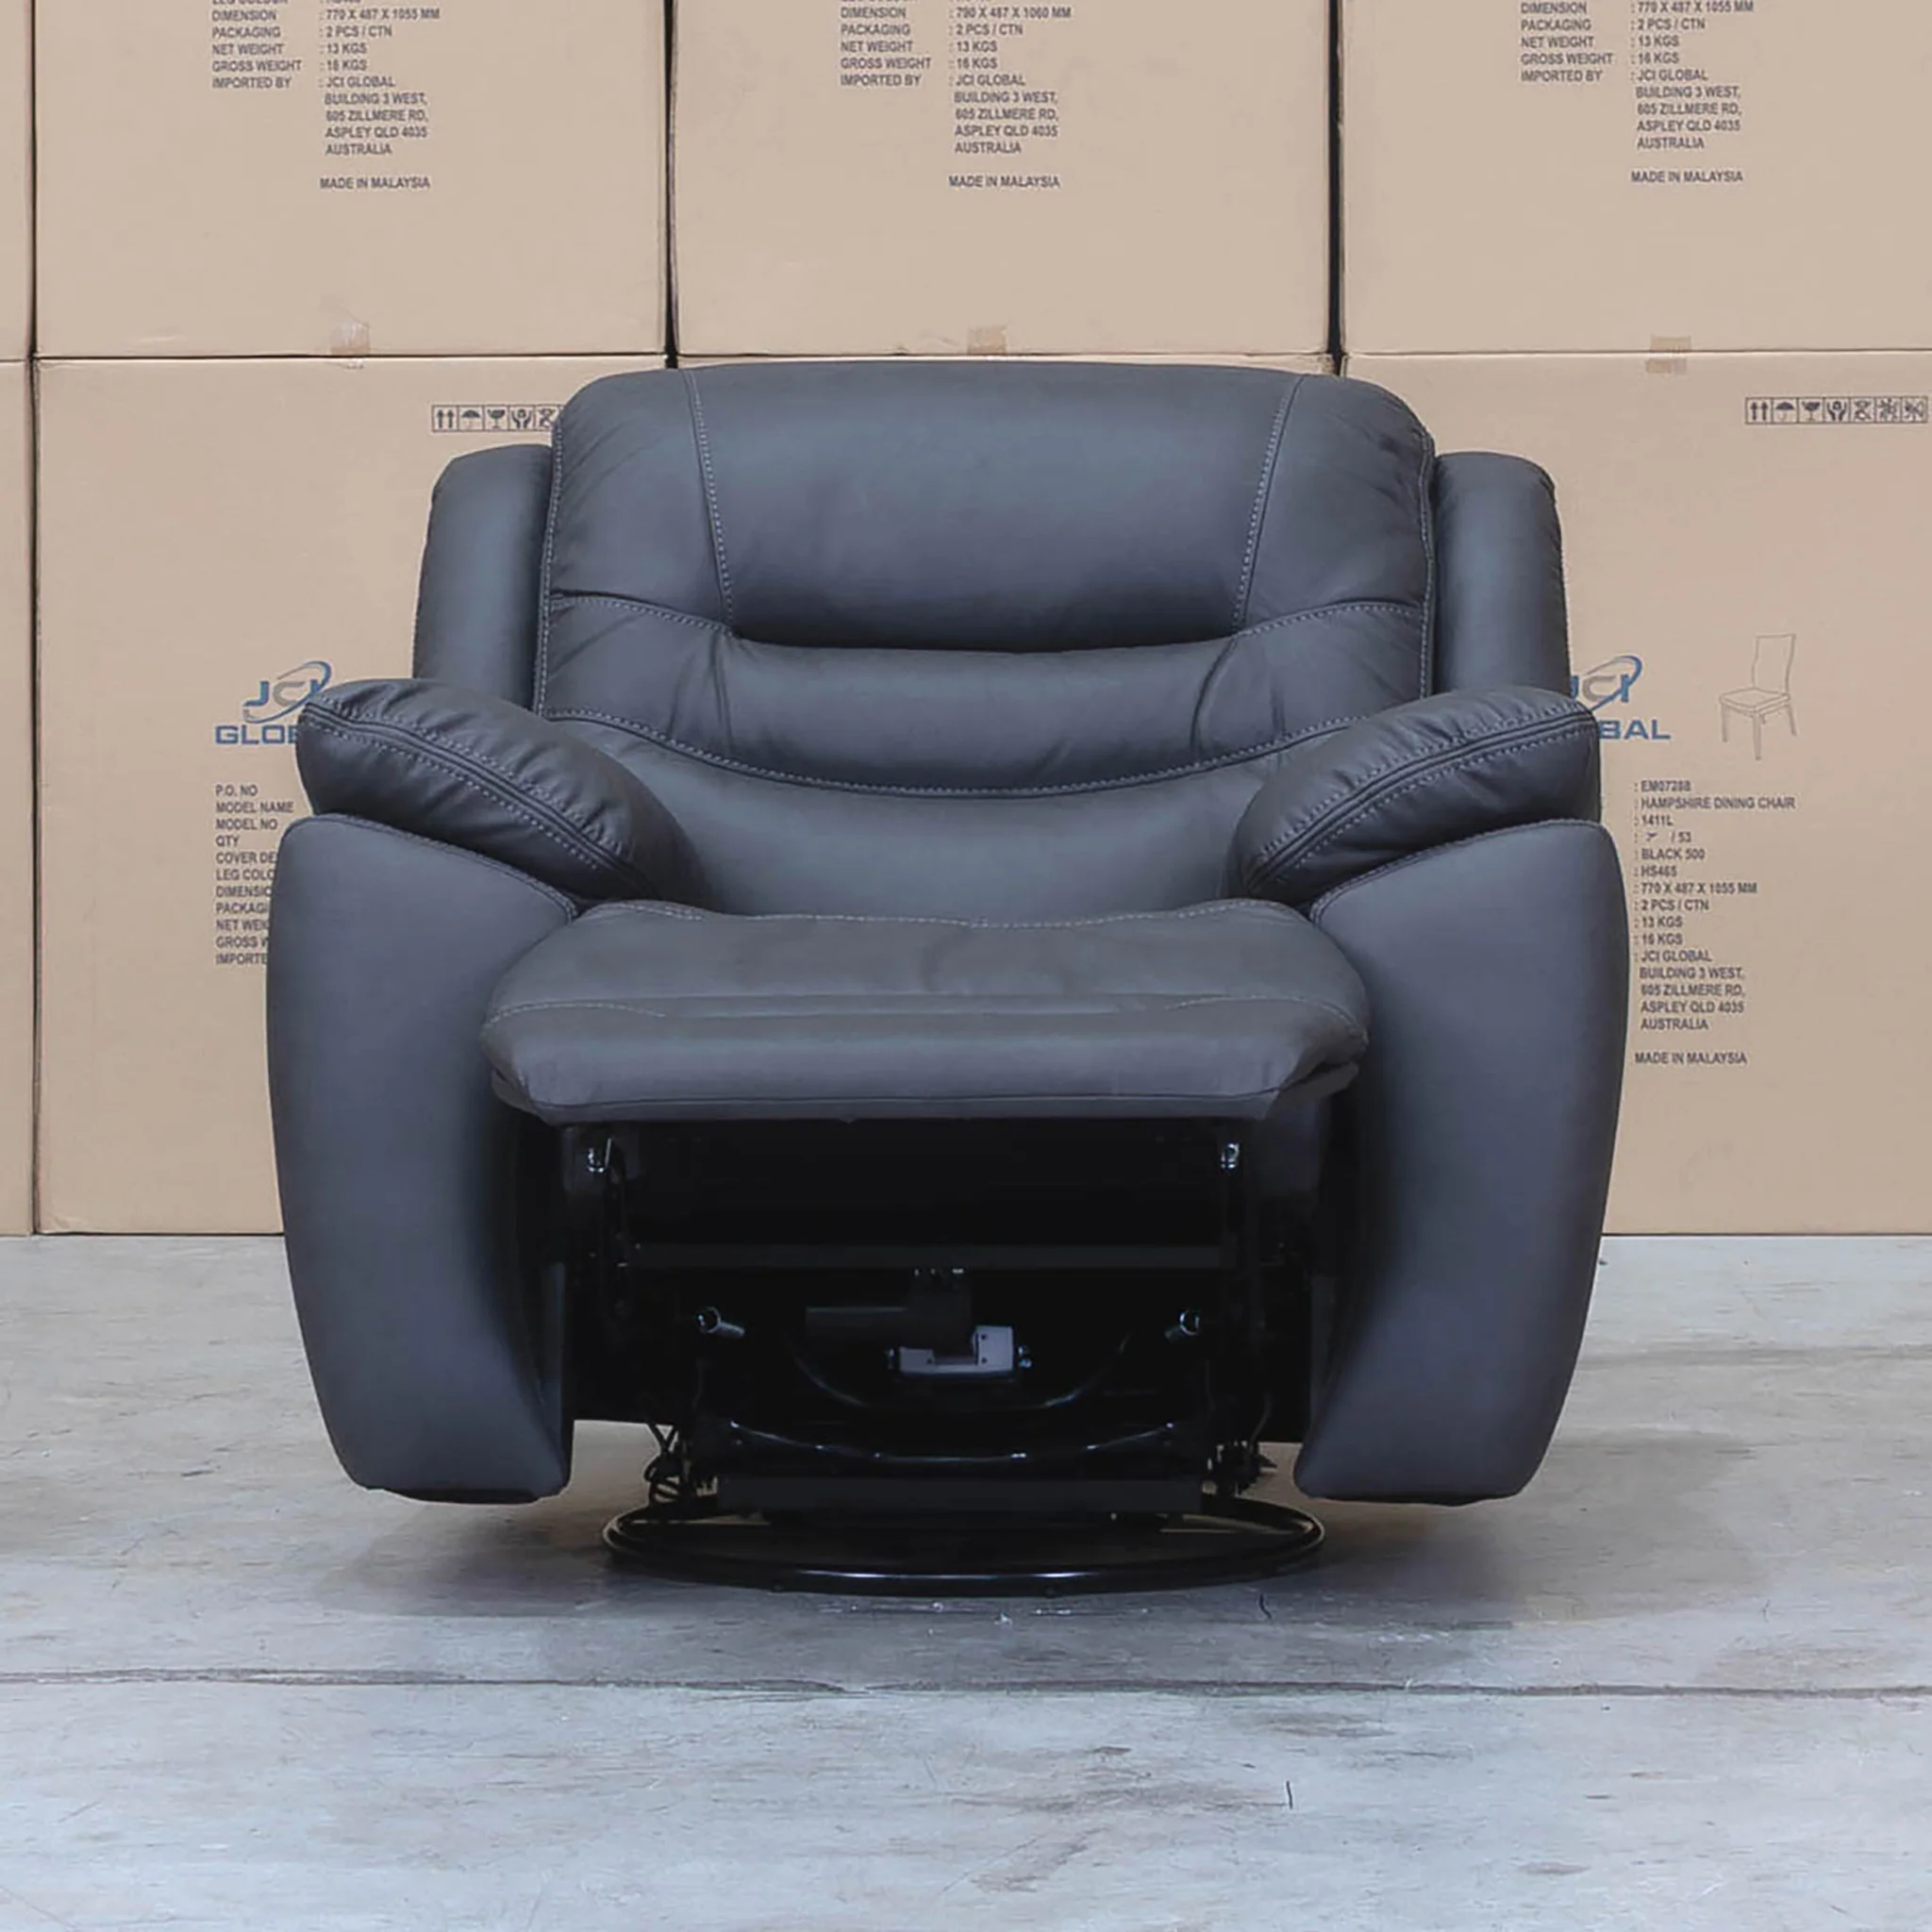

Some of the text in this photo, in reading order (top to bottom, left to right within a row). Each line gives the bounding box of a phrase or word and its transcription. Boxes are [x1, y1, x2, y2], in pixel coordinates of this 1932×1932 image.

[841, 7, 906, 19] DIMENSION
[1521, 2, 1587, 14] DIMENSION
[212, 9, 276, 22] DIMENSION
[841, 24, 910, 36] PACKAGING
[966, 24, 990, 36] PCS
[999, 24, 1023, 36] CTN
[1521, 19, 1591, 31] PACKAGING
[1647, 18, 1672, 30] PCS
[1680, 18, 1706, 30] CTN
[212, 26, 281, 38] PACKAGING
[335, 25, 358, 37] PCS
[368, 25, 392, 37] CTN
[841, 41, 913, 53] NET WEIGHT
[973, 41, 998, 53] KGS
[1521, 36, 1594, 48] NET WEIGHT
[1654, 35, 1679, 47] KGS
[212, 43, 284, 56] NET WEIGHT
[341, 42, 367, 54] KGS
[841, 58, 931, 70] GROSS WEIGHT
[972, 58, 998, 69] KGS
[1521, 53, 1613, 65] GROSS WEIGHT
[1654, 53, 1679, 64] KGS
[212, 59, 302, 73] GROSS WEIGHT
[341, 59, 367, 71] KGS
[841, 75, 922, 86] IMPORTED BY
[954, 75, 1025, 86] JCI GLOBAL
[1521, 70, 1603, 82] IMPORTED BY
[1636, 69, 1708, 81] JCI GLOBAL
[212, 77, 291, 89] IMPORTED BY
[325, 76, 396, 88] JCI GLOBAL
[954, 92, 1010, 103] BUILDING
[1636, 86, 1692, 98] BUILDING
[325, 93, 380, 105] BUILDING
[977, 108, 1036, 121] ZILLMERE
[1659, 103, 1719, 115] ZILLMERE
[347, 109, 406, 122] ZILLMERE
[955, 125, 1002, 137] ASPLEY
[1003, 125, 1029, 137] QLD
[1636, 120, 1684, 132] ASPLEY
[1686, 120, 1711, 132] QLD
[325, 126, 372, 139] ASPLEY
[374, 126, 399, 139] QLD
[955, 142, 1022, 154] AUSTRALIA
[1637, 137, 1705, 149] AUSTRALIA
[325, 143, 392, 156] AUSTRALIA
[320, 177, 430, 189] MADE IN MALAYSIA
[948, 175, 1060, 188] MADE IN MALAYSIA
[1631, 171, 1743, 183] MADE IN MALAYSIA
[216, 725, 297, 744] GLO
[1600, 720, 1671, 740] BAL
[215, 784, 258, 797] P.O. NO
[216, 802, 294, 814] MODEL NAME
[1641, 797, 1796, 809] HAMPSHIRE DINING CHAIR
[215, 819, 278, 831] MODEL NO
[215, 835, 240, 847] QTY
[216, 852, 258, 864] COVER
[1641, 848, 1682, 860] BLACK
[216, 869, 275, 881] LEG COLO
[216, 886, 272, 897] DIMENSIO
[1651, 899, 1675, 911] PCS
[1684, 899, 1709, 911] CTN
[216, 919, 239, 931] NET
[1657, 916, 1683, 927] KGS
[215, 936, 259, 949] GROSS
[1657, 933, 1683, 944] KGS
[216, 953, 267, 964] IMPORTE
[1641, 950, 1712, 962] JCI GLOBAL
[1640, 967, 1696, 978] BUILDING
[1663, 984, 1722, 996] ZILLMERE
[1641, 1001, 1688, 1013] ASPLEY
[1690, 1001, 1715, 1013] QLD
[1641, 1019, 1708, 1030] AUSTRALIA
[1635, 1052, 1747, 1064] MADE IN MALAYSIA
